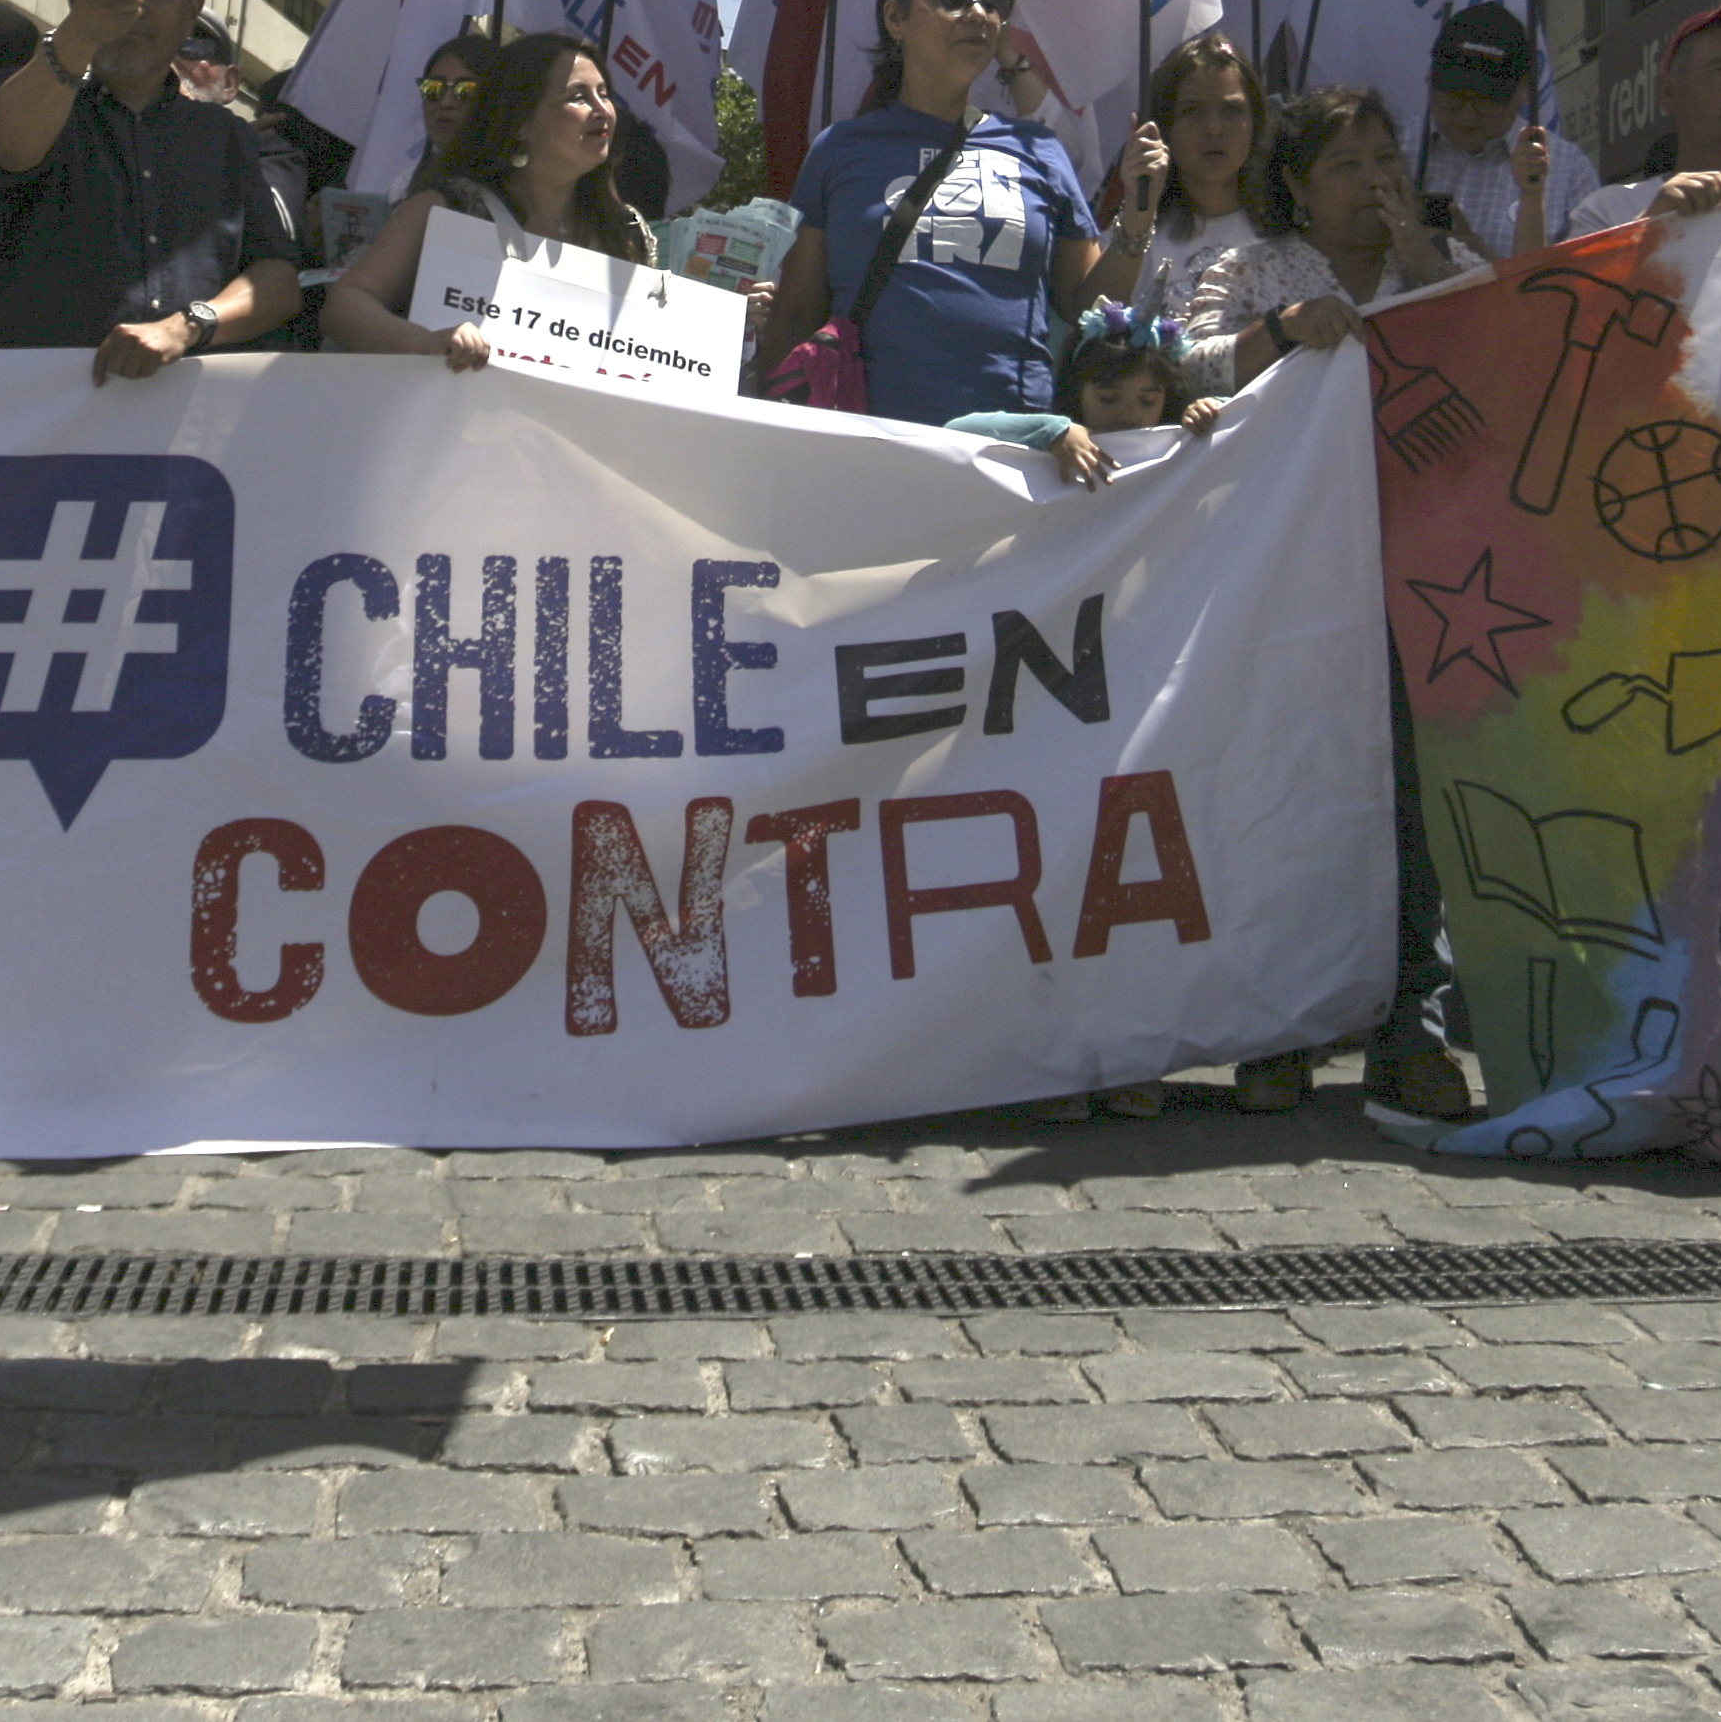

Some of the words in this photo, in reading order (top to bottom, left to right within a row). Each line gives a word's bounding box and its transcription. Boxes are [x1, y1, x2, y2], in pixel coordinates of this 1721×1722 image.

[611, 35, 677, 108] EN
[443, 286, 501, 320] Este
[511, 306, 542, 330] 17
[548, 317, 581, 341] de
[588, 329, 712, 377] diciembre
[834, 592, 1112, 746] EN
[189, 768, 1212, 1038] CONTRA
